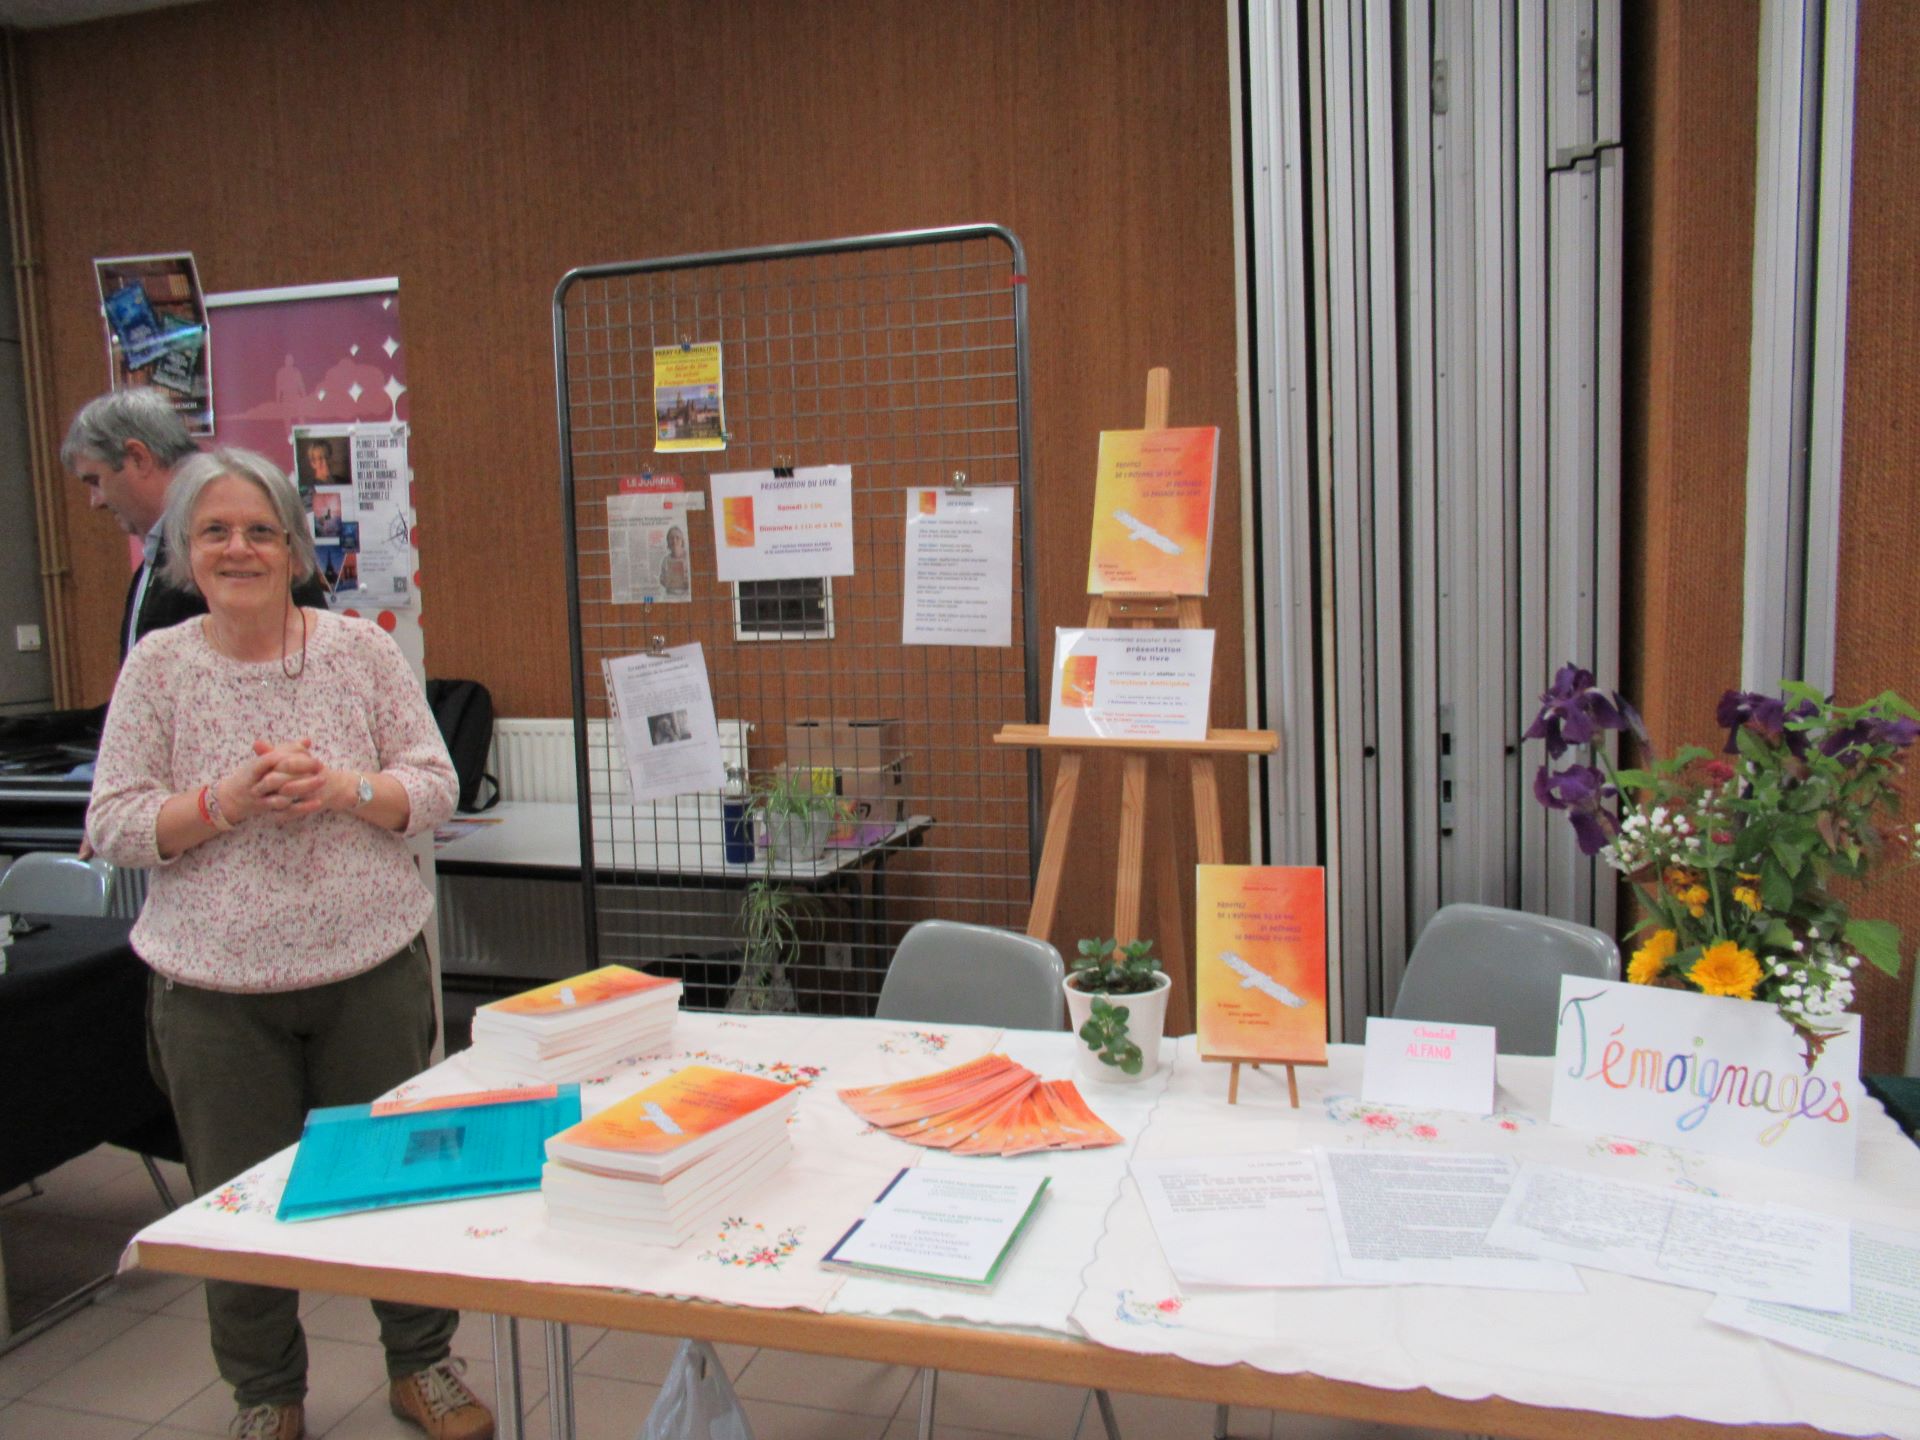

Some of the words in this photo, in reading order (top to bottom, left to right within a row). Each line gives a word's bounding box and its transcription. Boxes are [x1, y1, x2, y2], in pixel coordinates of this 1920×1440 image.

[626, 479, 637, 488] LE
[638, 476, 676, 488] JOURNAL
[808, 479, 817, 488] DU
[819, 478, 838, 487] LIVRE
[777, 503, 802, 511] Samedi
[760, 524, 792, 532] Dimanche
[1126, 645, 1181, 654] présentation
[1413, 1026, 1457, 1041] Chantal
[1404, 1041, 1452, 1060] ALFANO
[1560, 989, 1850, 1147] Témoignages
